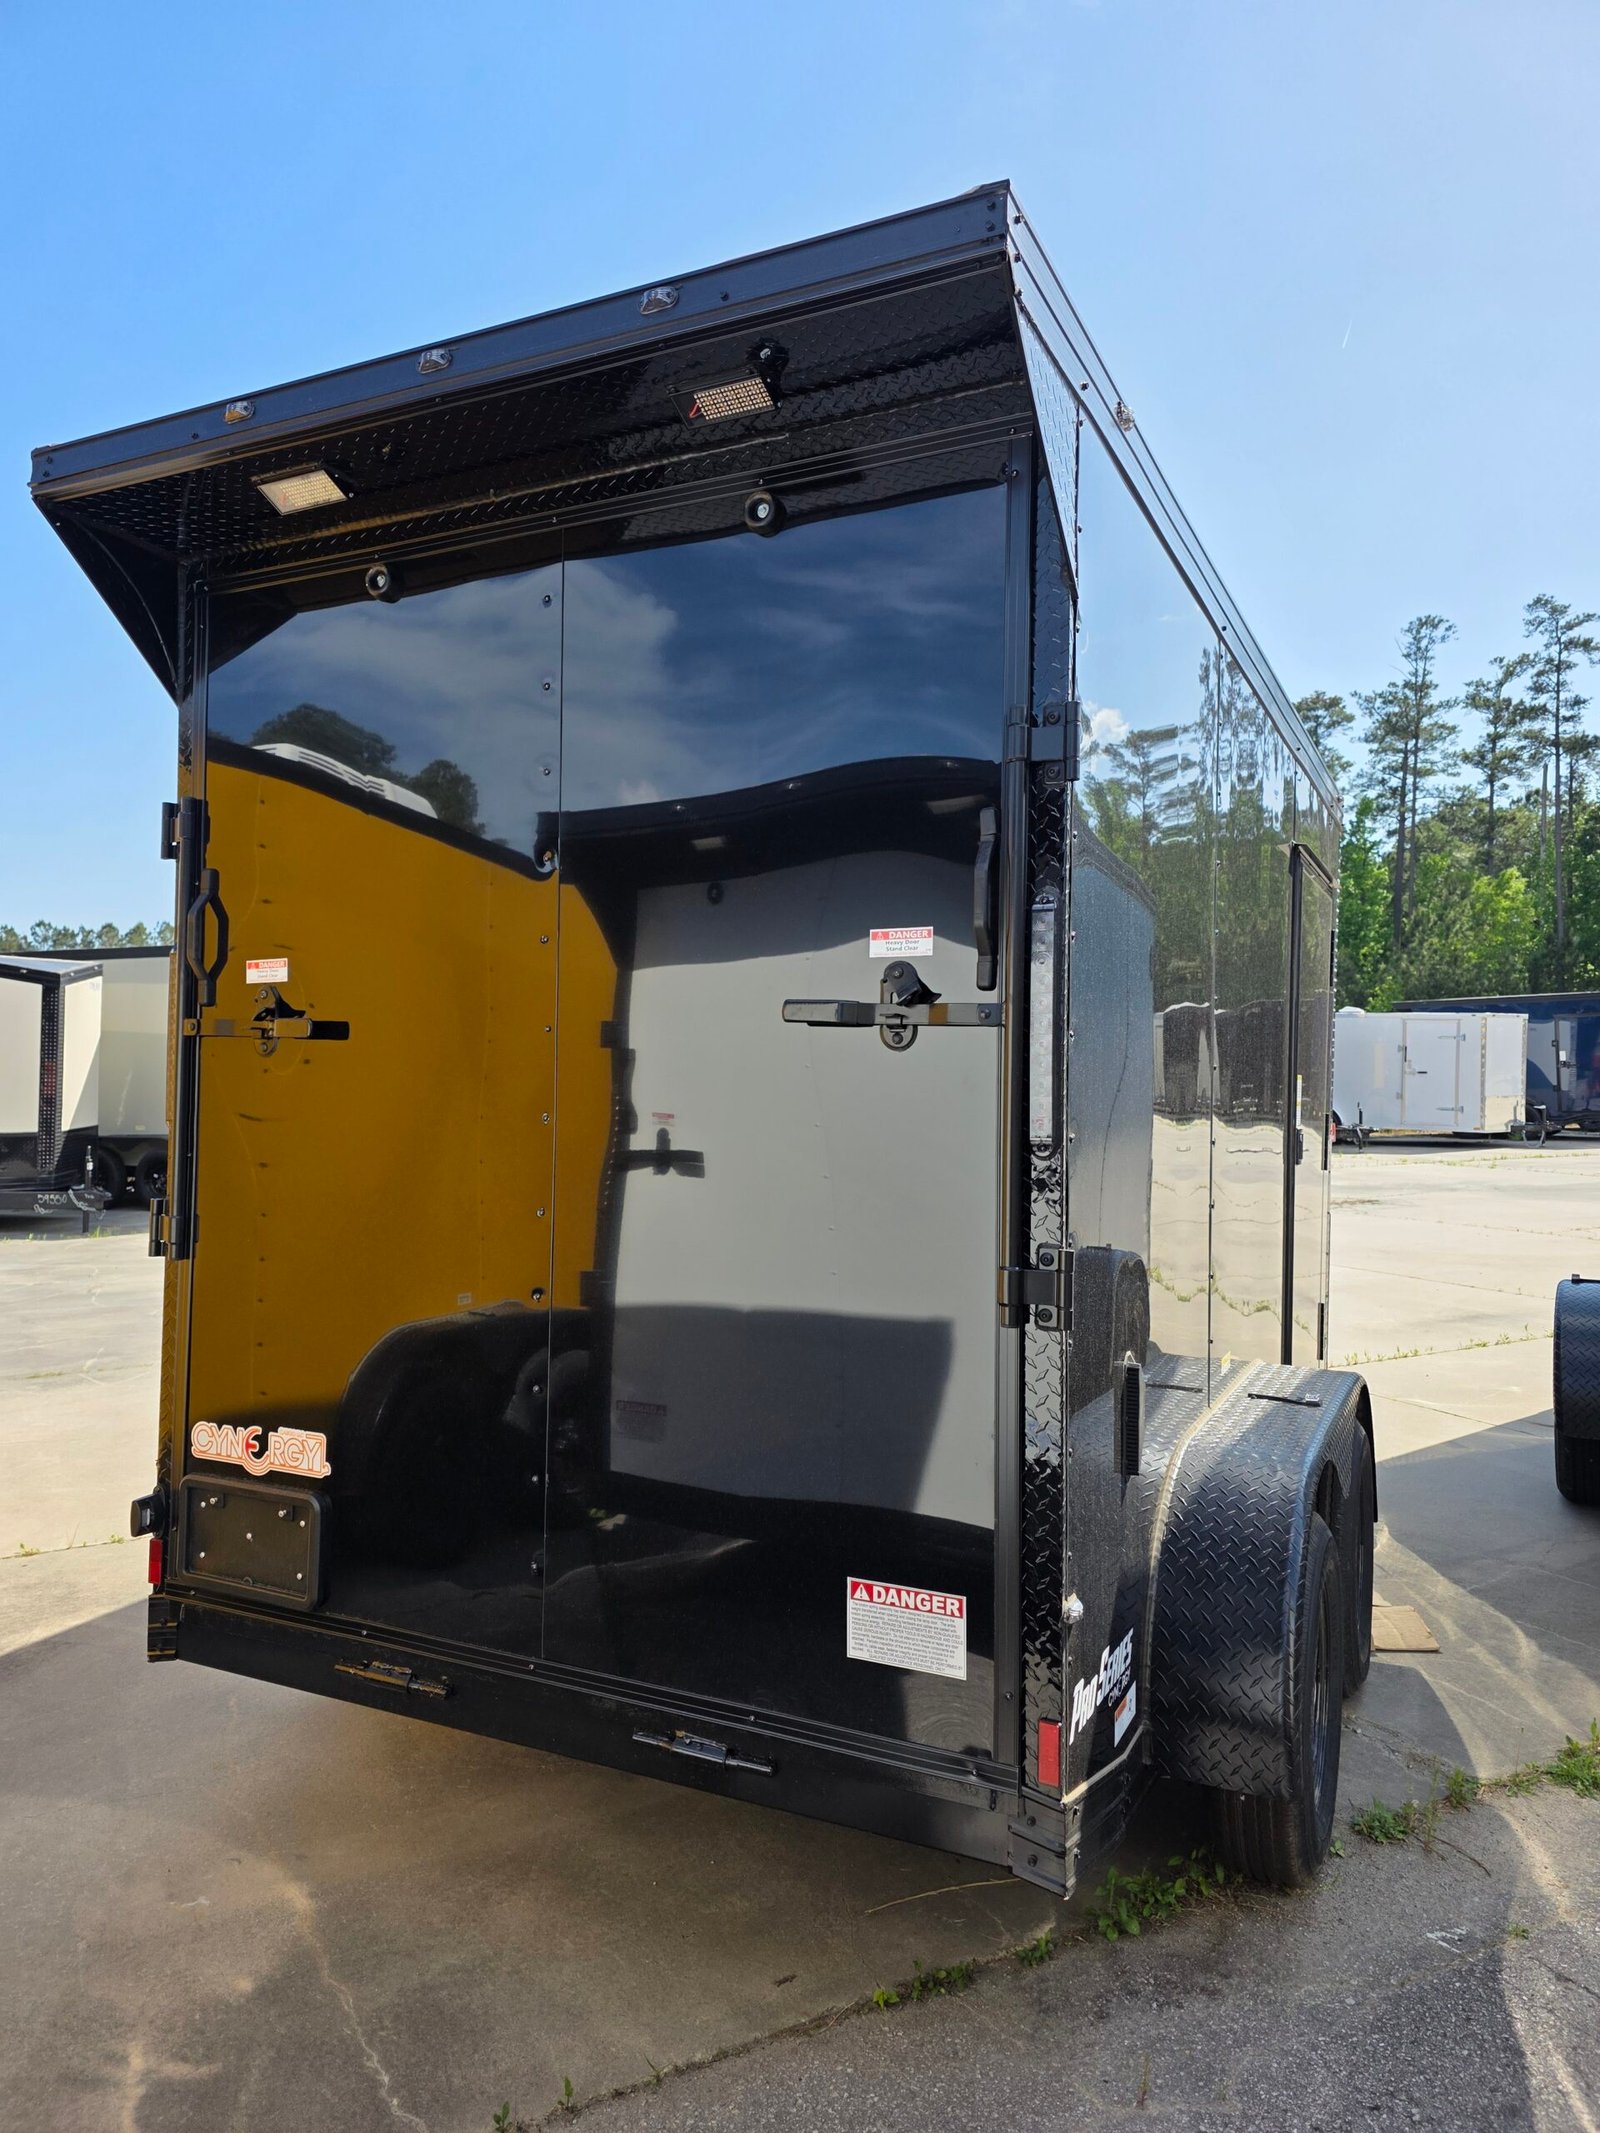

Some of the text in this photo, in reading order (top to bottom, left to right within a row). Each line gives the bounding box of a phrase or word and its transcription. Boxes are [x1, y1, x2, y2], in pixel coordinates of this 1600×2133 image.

[889, 930, 929, 939] DANGER
[192, 1423, 322, 1472] CYNERGY
[872, 1585, 961, 1617] DANGER
[1069, 1627, 1134, 1746] PRO SERIES
